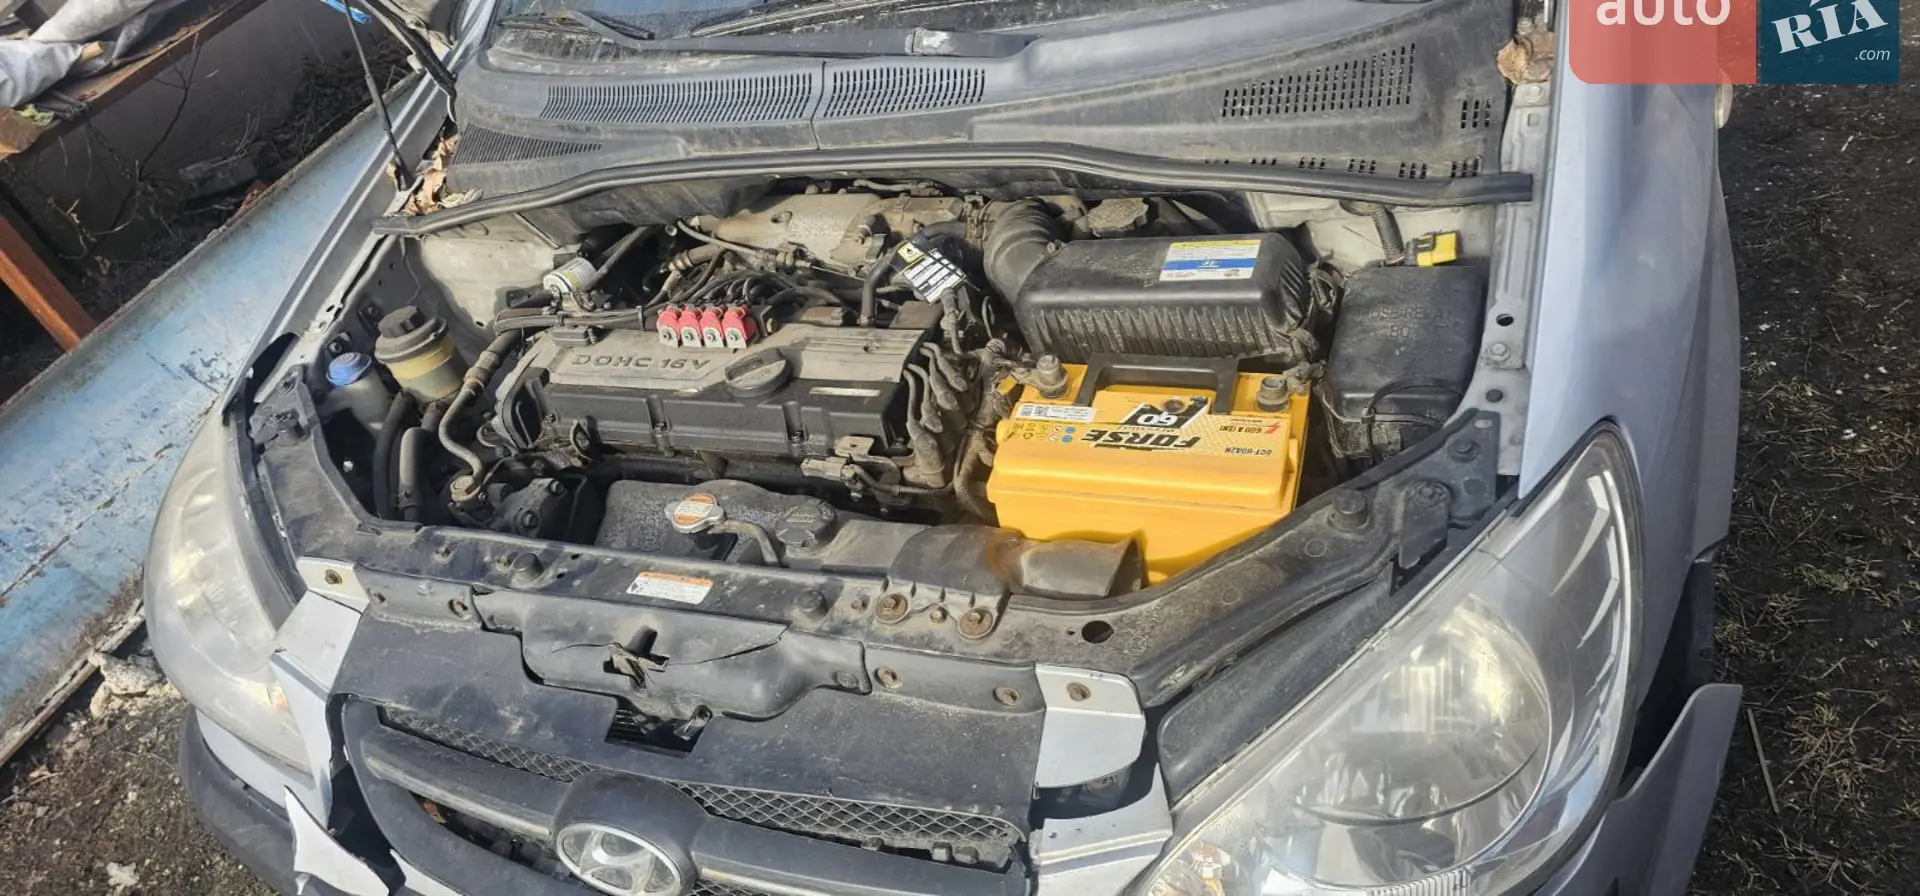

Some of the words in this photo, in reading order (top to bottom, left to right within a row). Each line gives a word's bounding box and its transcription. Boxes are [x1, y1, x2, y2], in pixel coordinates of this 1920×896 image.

[572, 355, 652, 367] DOHC
[661, 358, 711, 370] 16V
[1137, 413, 1178, 425] 60
[1081, 429, 1201, 448] FORSE
